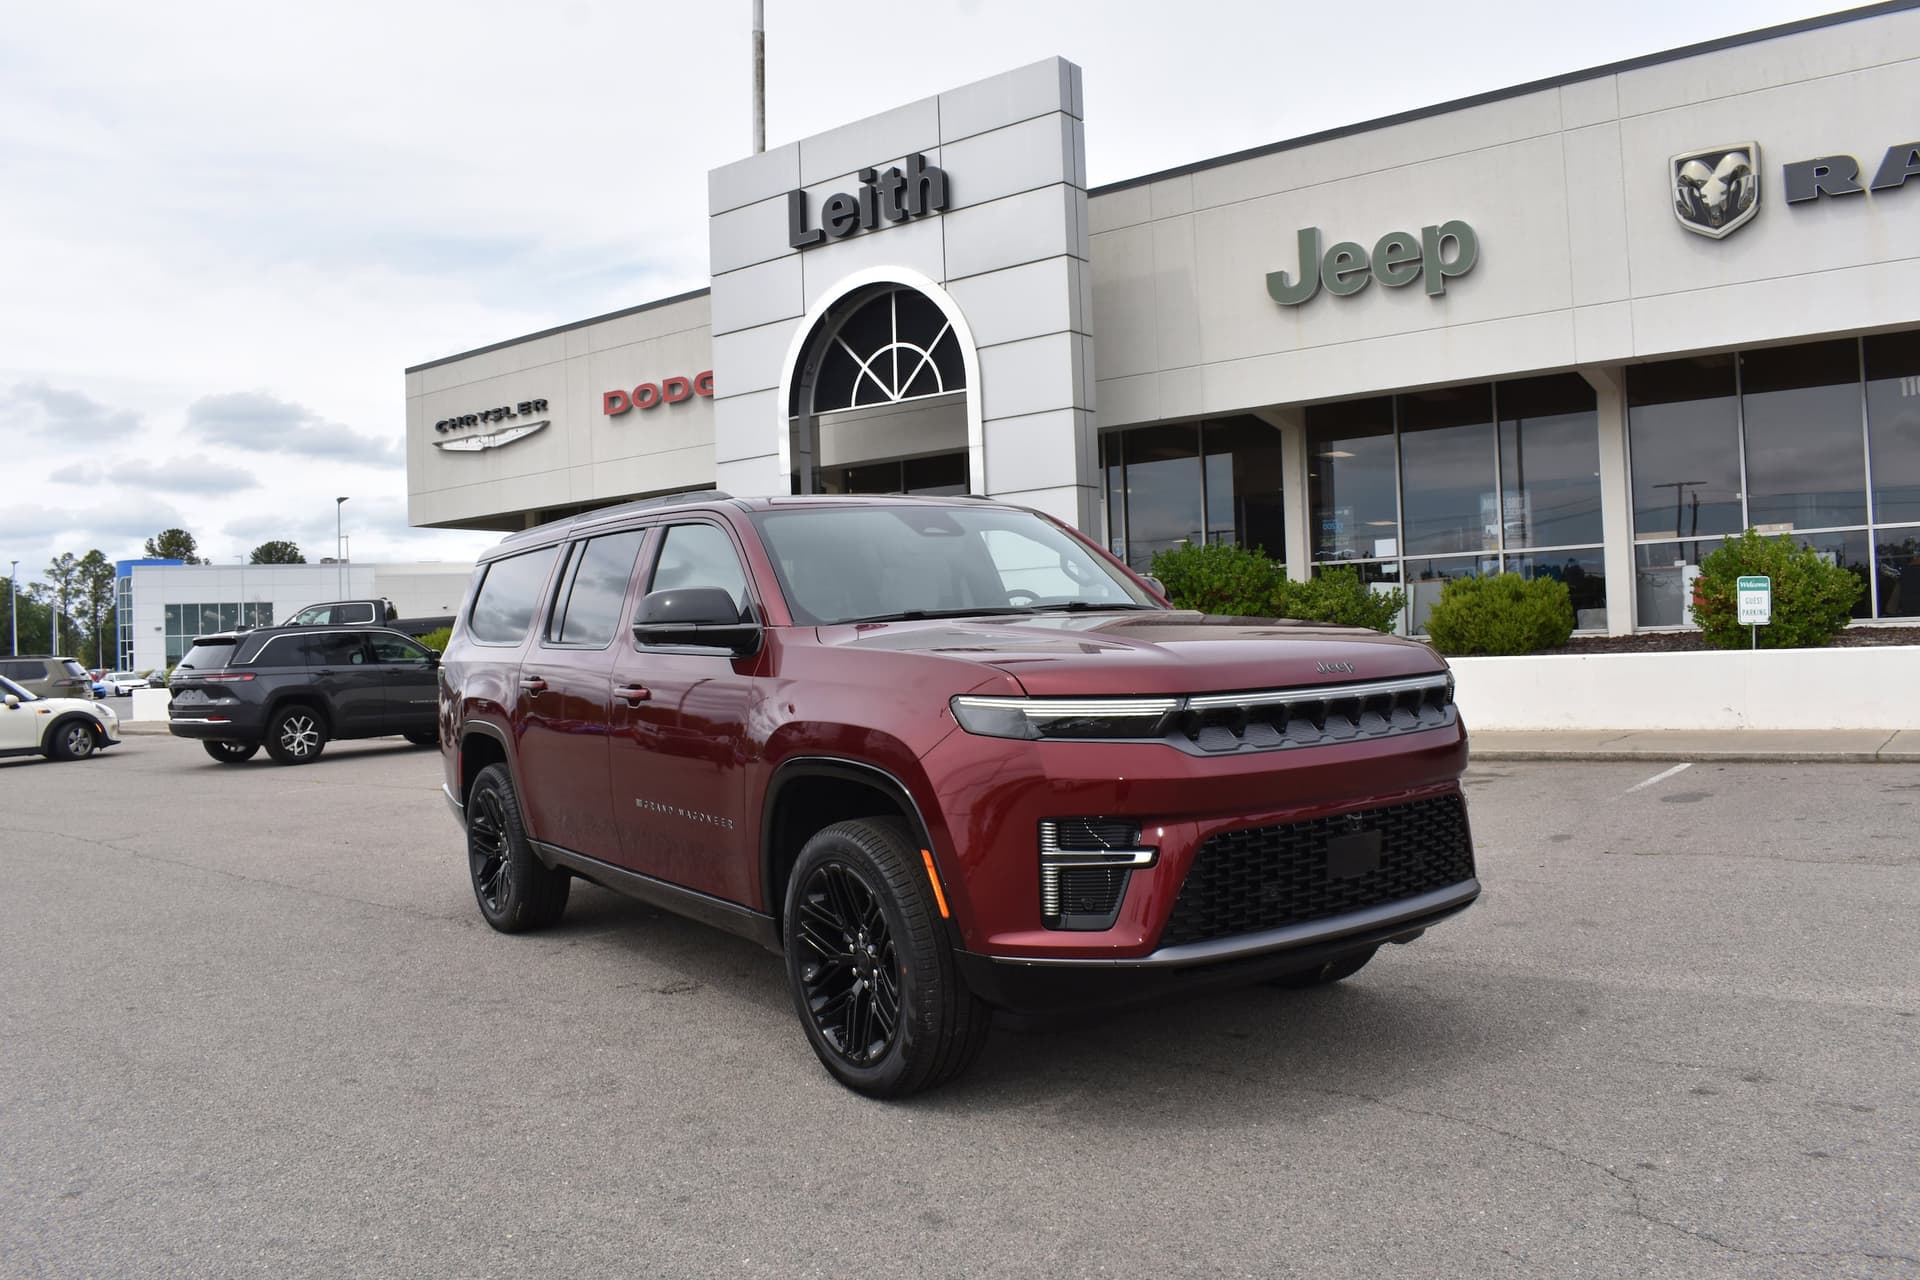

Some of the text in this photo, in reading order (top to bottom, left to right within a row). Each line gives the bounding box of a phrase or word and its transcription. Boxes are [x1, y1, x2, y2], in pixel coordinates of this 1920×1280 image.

[788, 152, 950, 250] Leith
[1265, 220, 1480, 306] Jeep
[435, 398, 548, 433] CHRYSLER
[1742, 608, 1768, 617] PARKING
[1745, 597, 1763, 605] GUEST
[1315, 660, 1354, 674] Jeep
